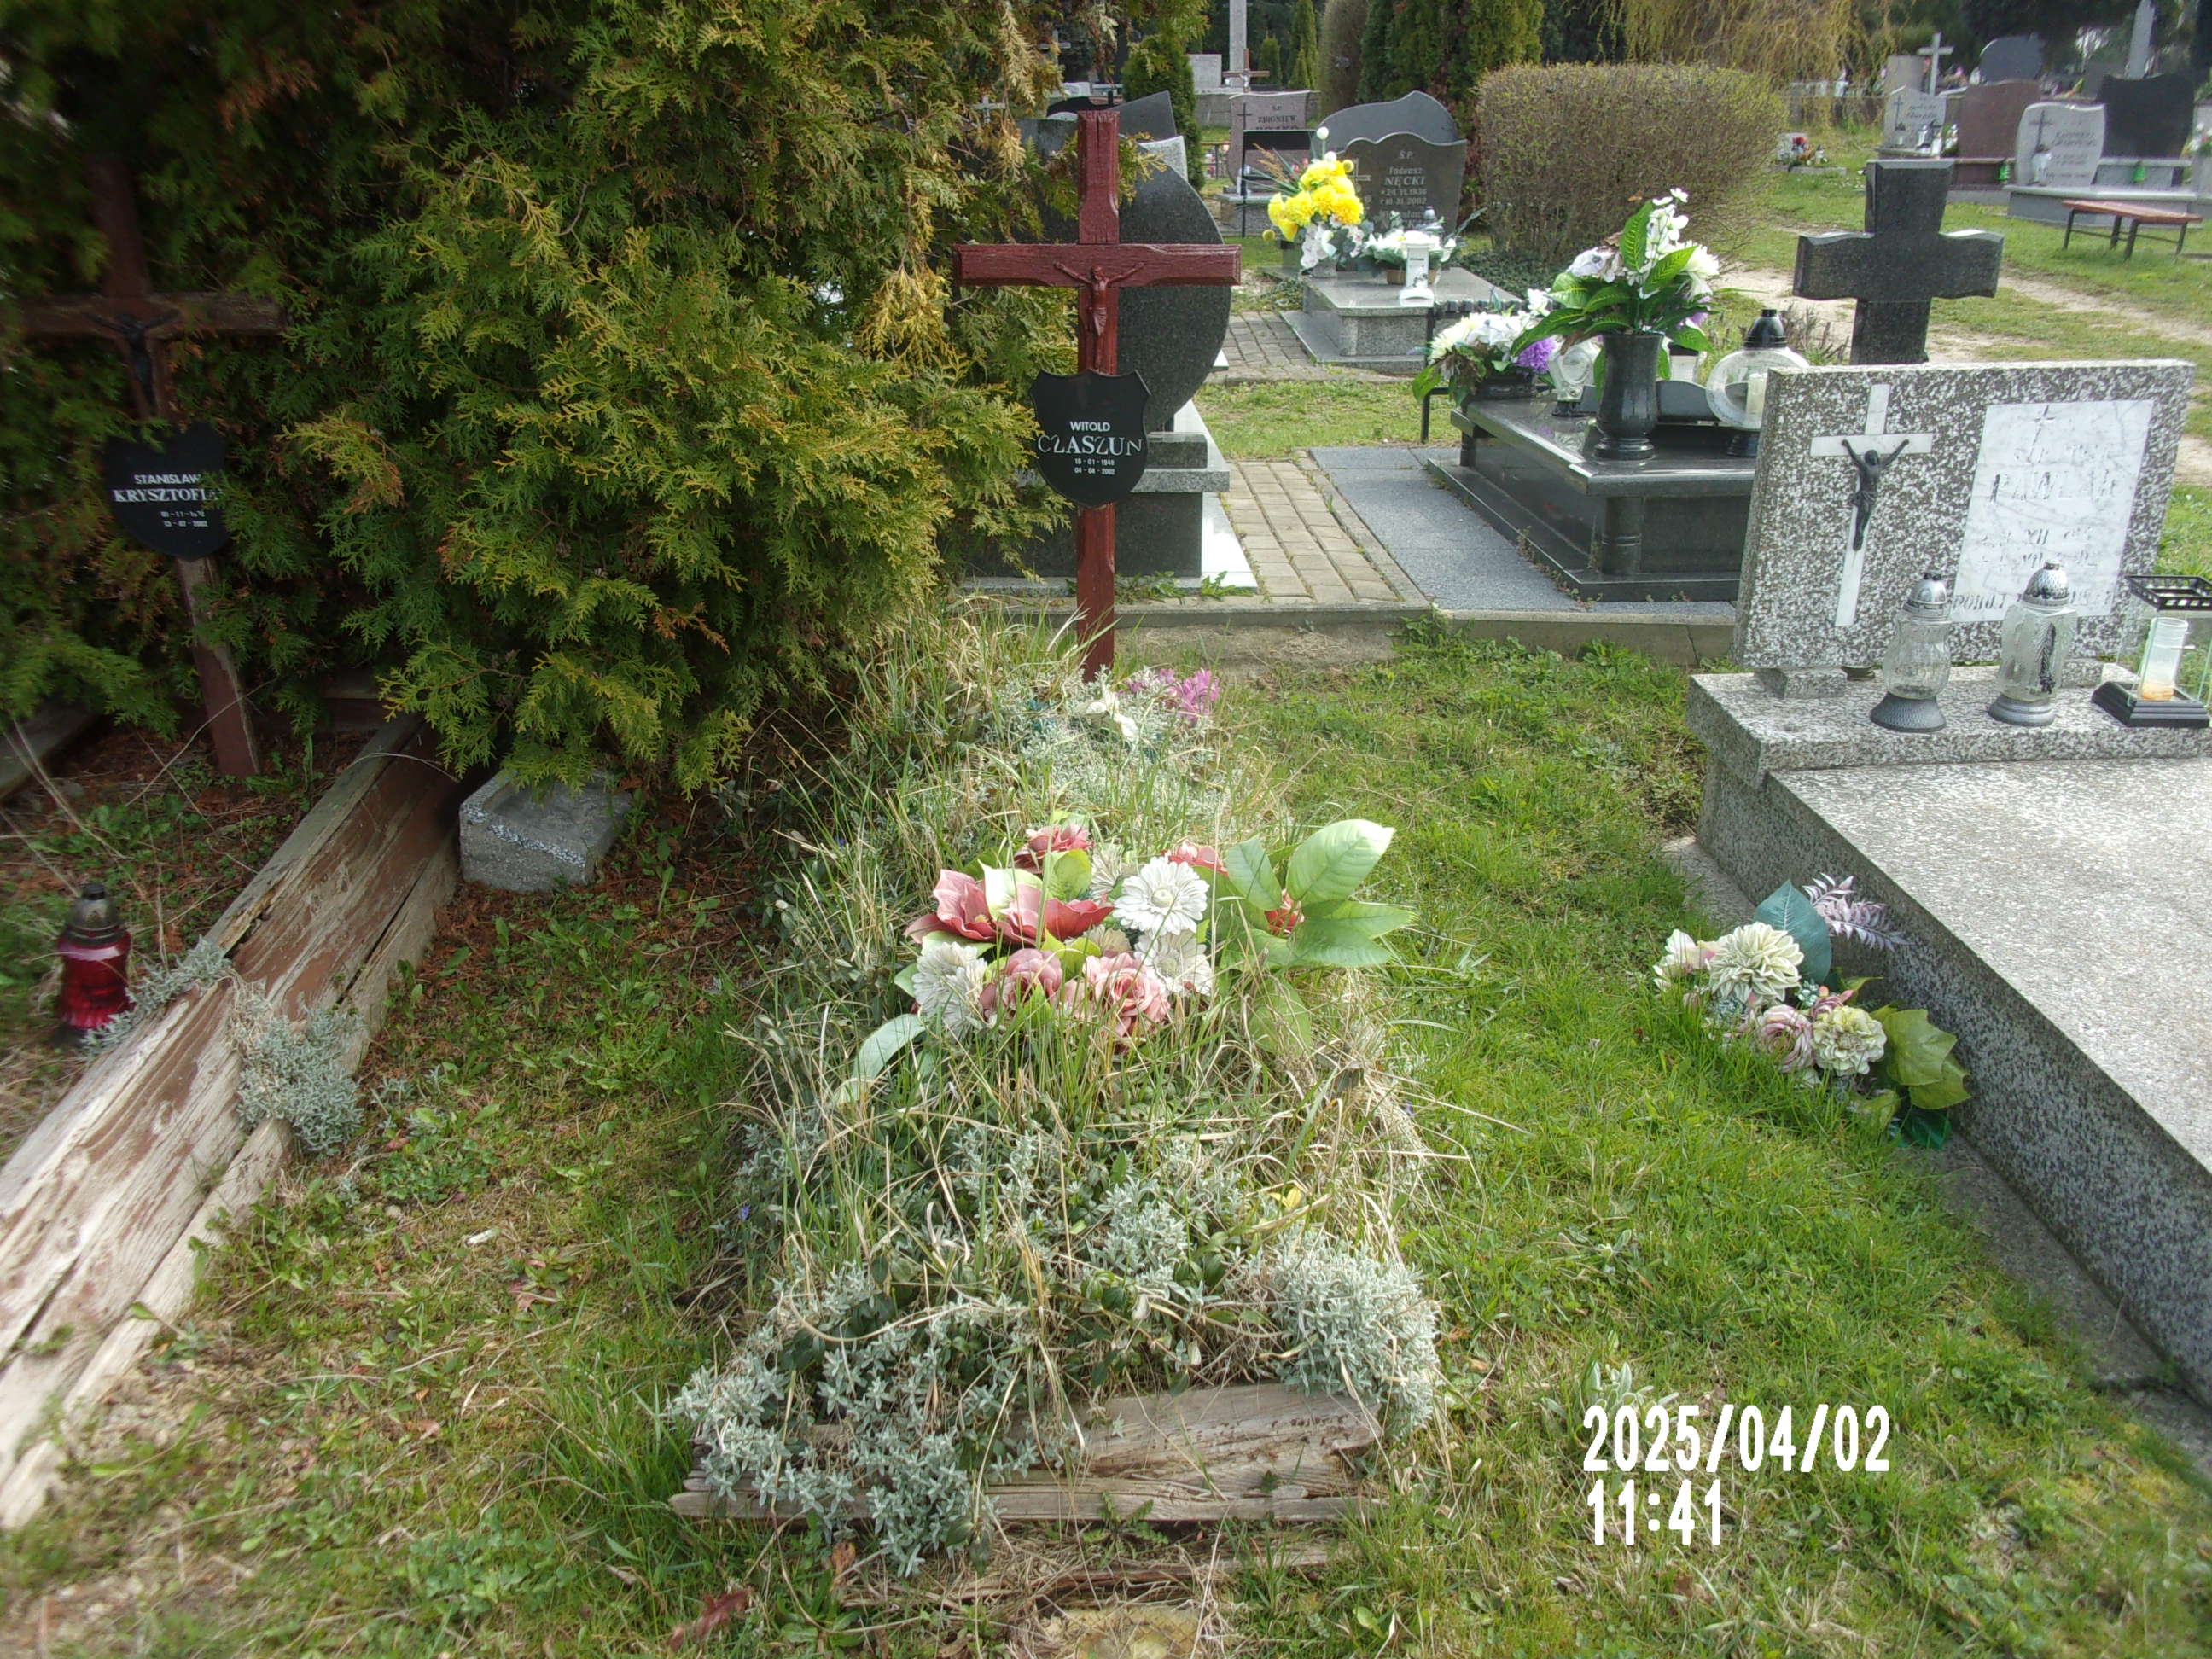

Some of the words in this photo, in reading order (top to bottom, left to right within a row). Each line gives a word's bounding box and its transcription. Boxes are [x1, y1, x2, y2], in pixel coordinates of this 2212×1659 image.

[1384, 176, 1426, 188] NĘCKI
[1069, 421, 1111, 433] WITOLD
[1038, 434, 1143, 457] CZASZUN
